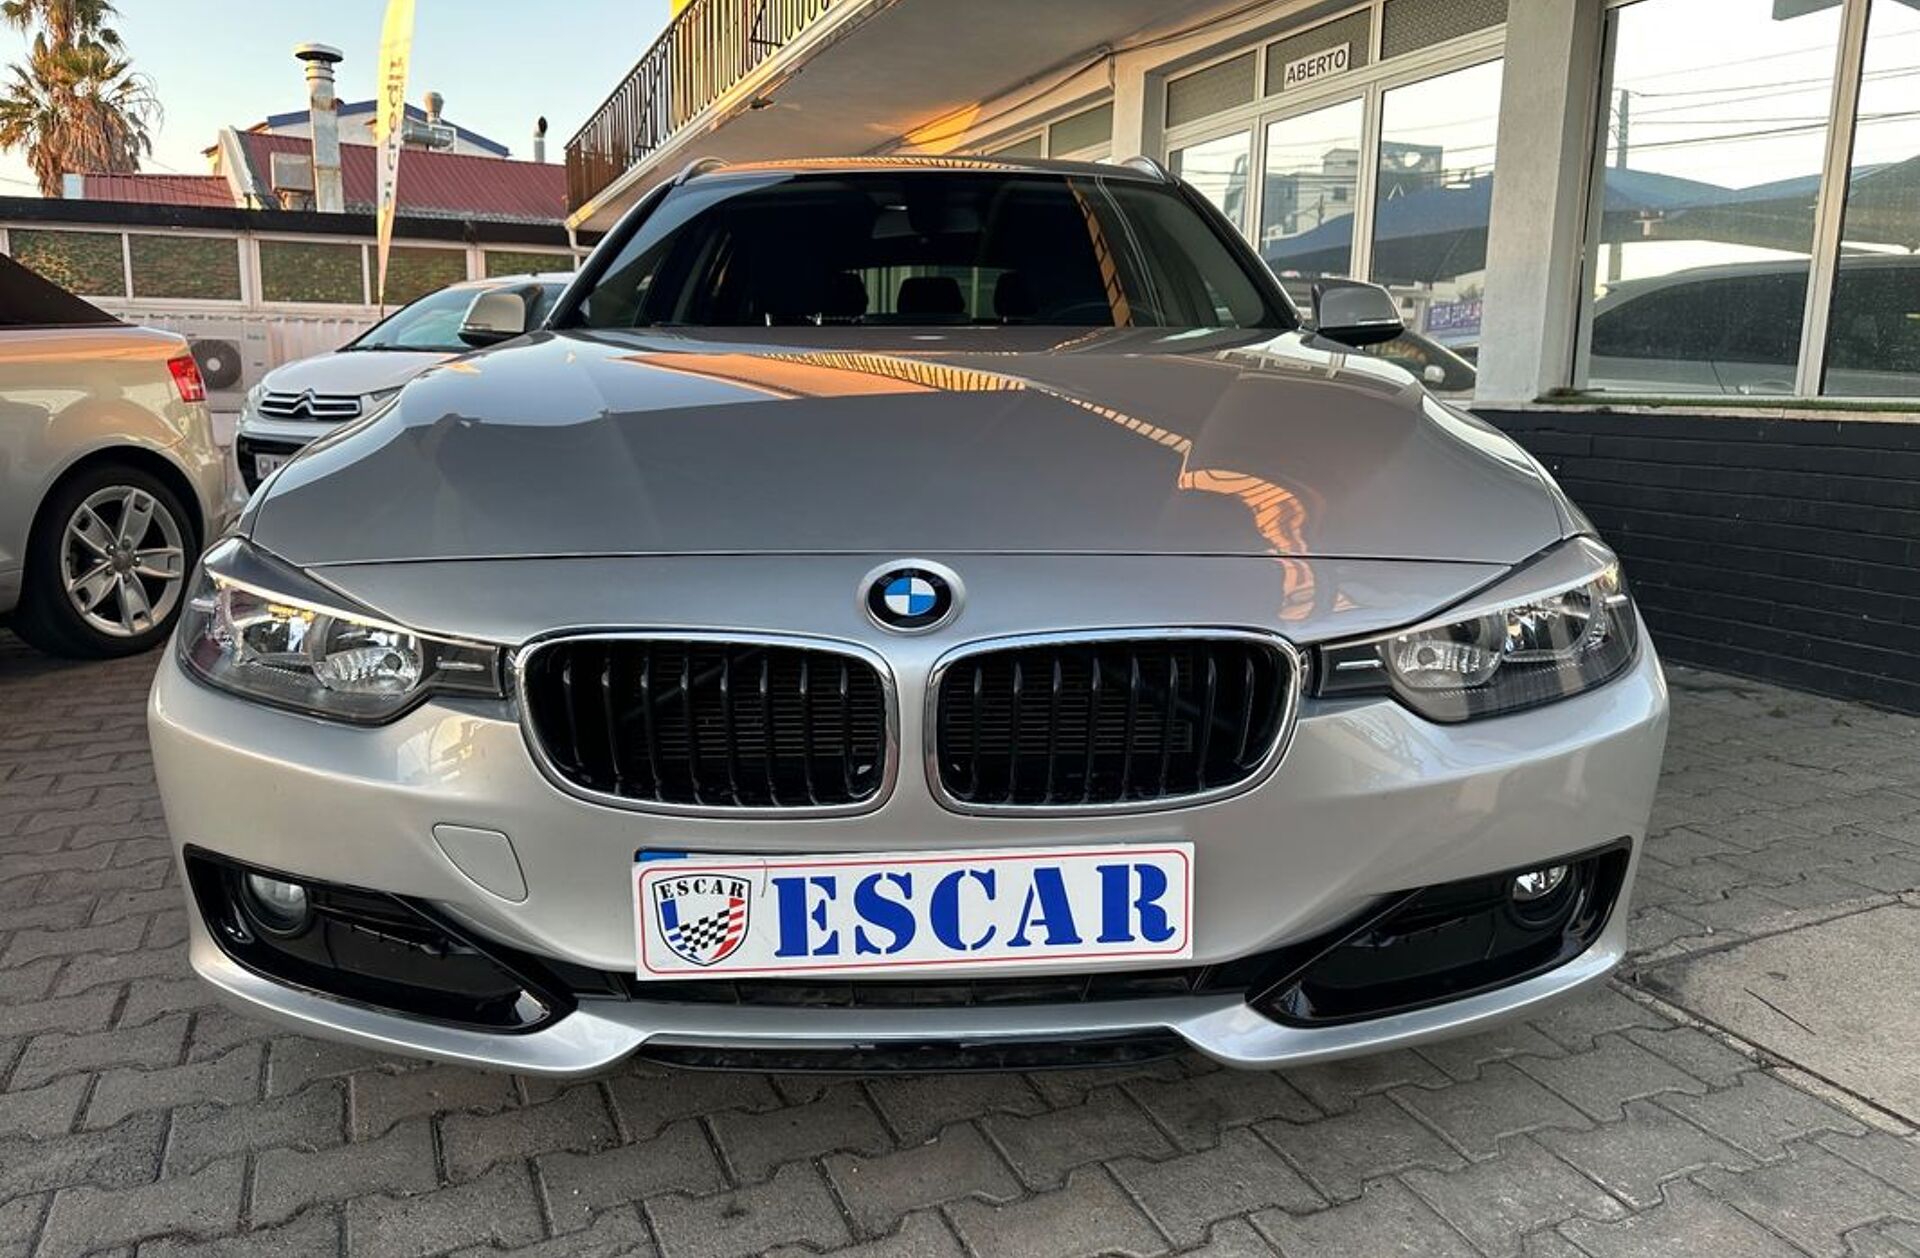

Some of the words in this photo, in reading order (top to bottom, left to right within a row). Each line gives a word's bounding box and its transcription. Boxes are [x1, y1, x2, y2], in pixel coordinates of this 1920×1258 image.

[1287, 49, 1346, 83] ABERTO
[659, 879, 744, 899] ESCAR
[771, 863, 1177, 957] ESCAR
